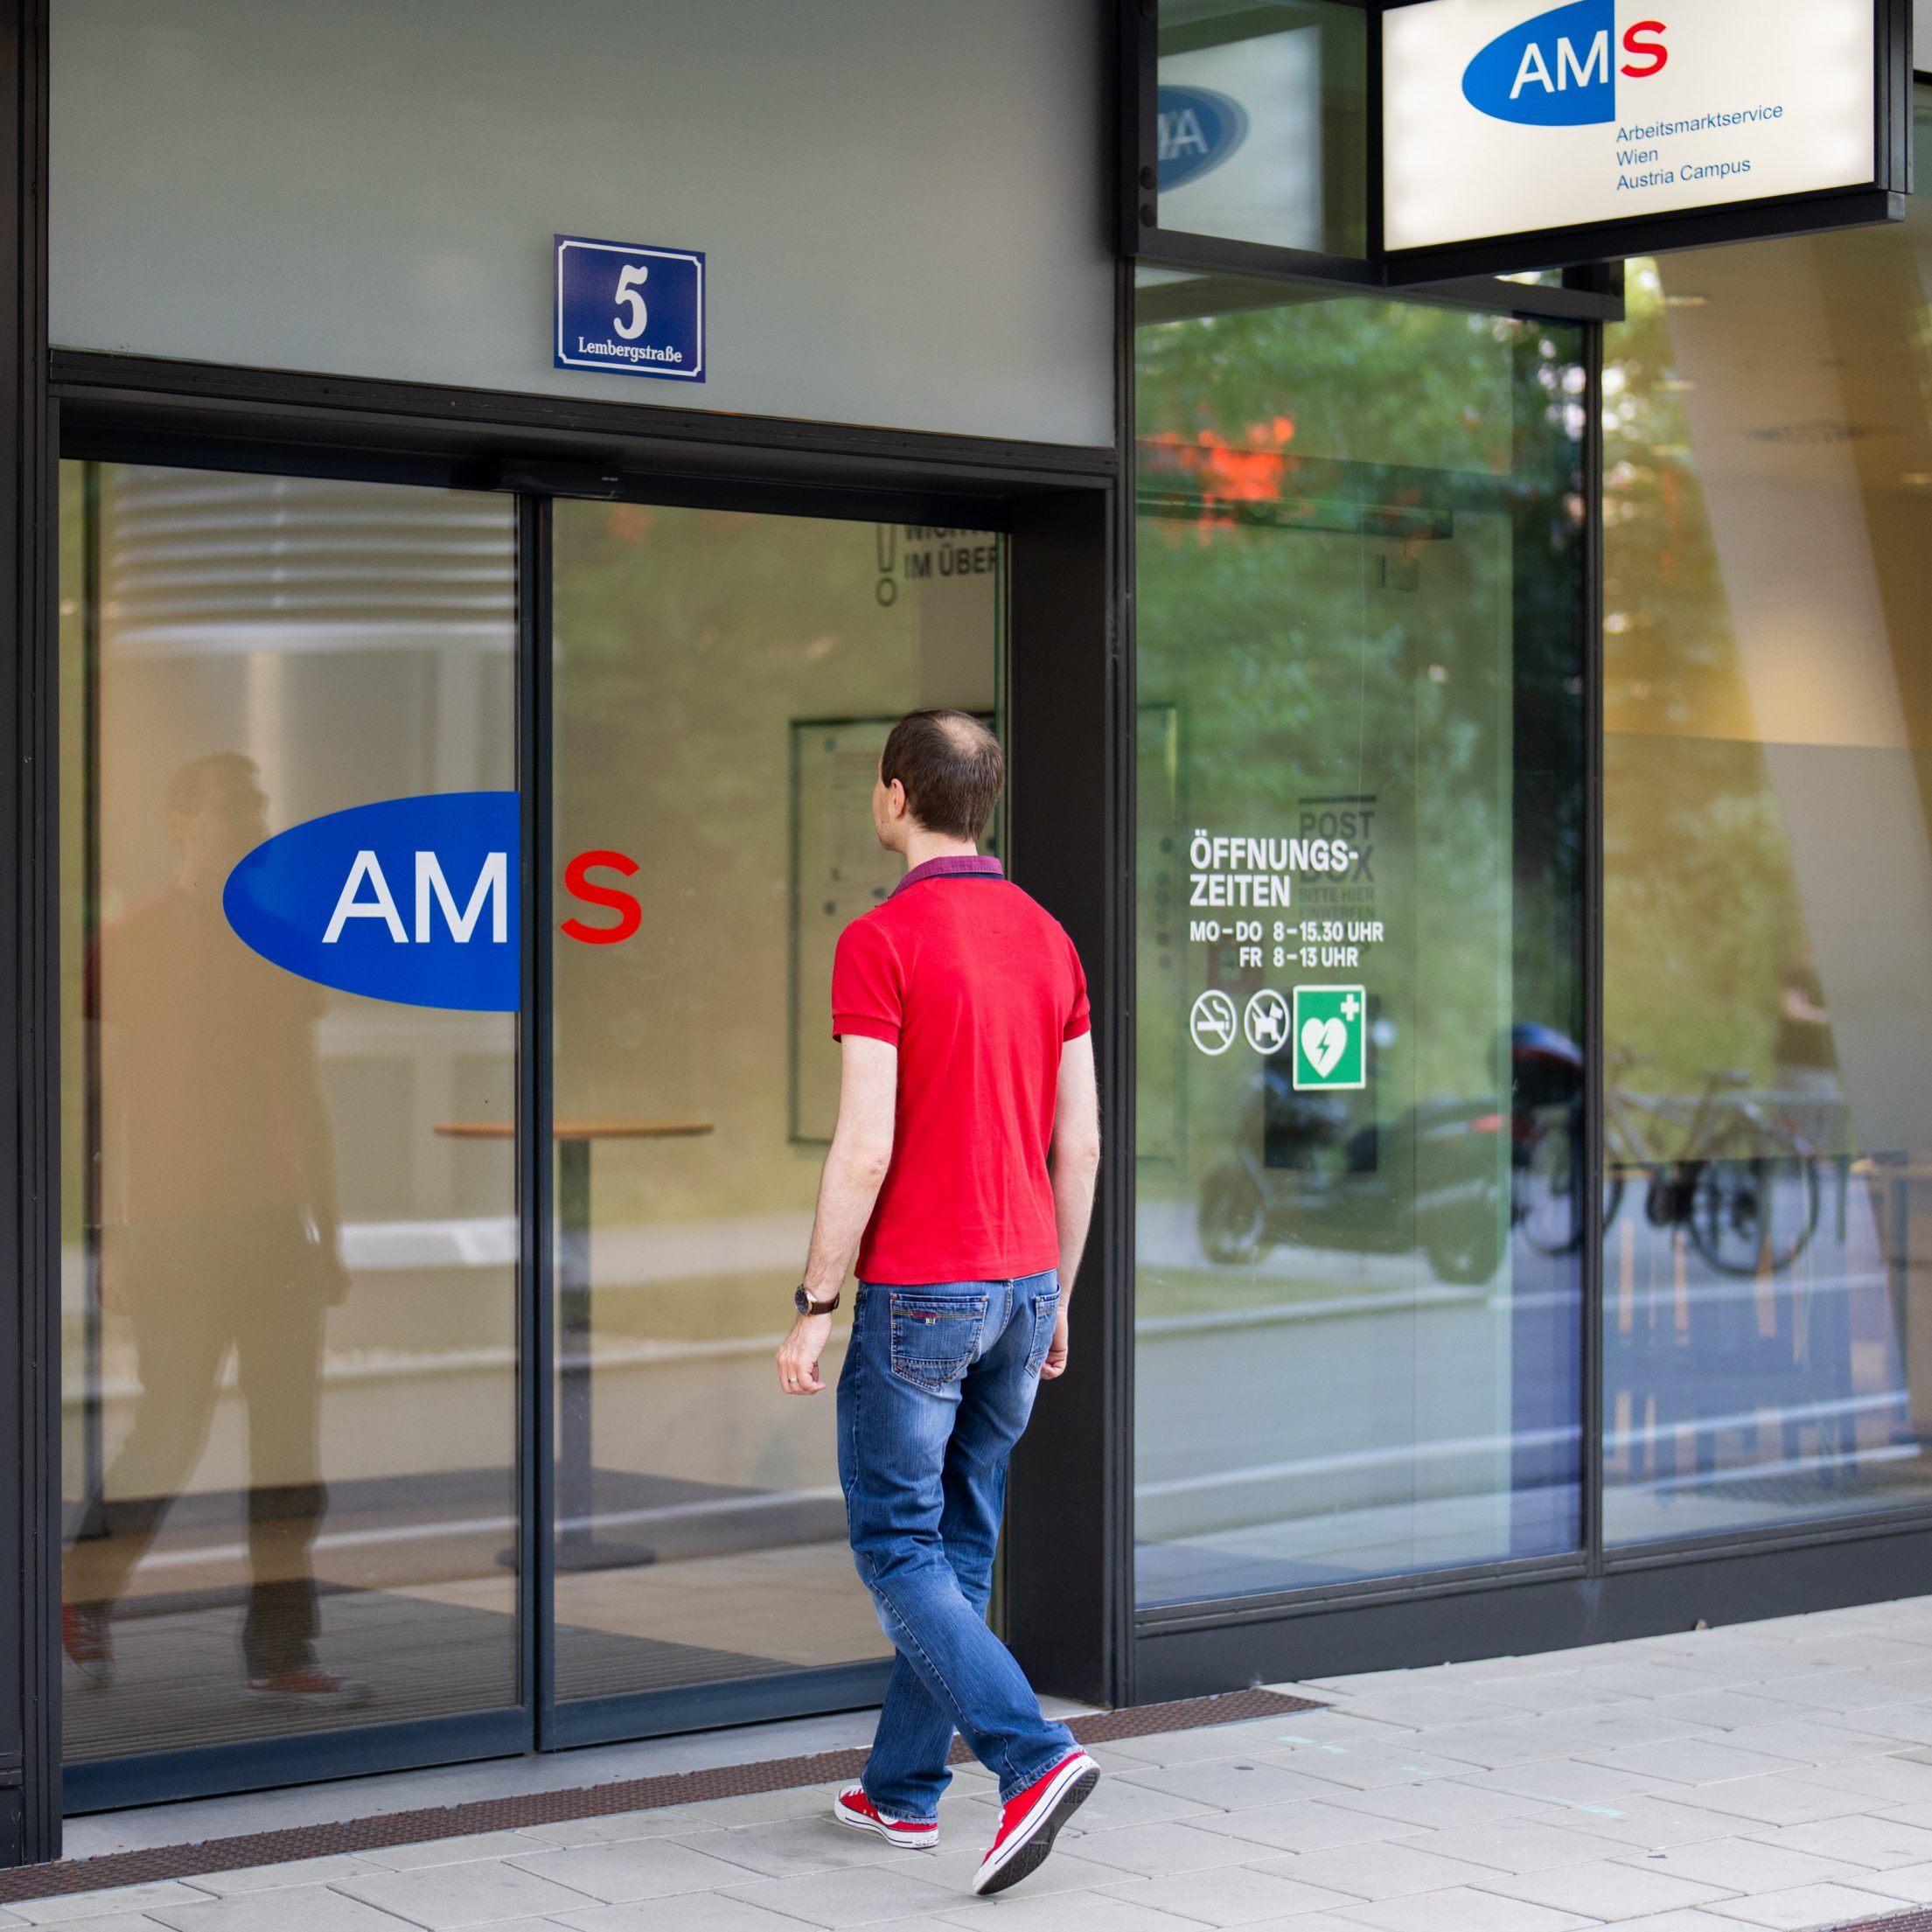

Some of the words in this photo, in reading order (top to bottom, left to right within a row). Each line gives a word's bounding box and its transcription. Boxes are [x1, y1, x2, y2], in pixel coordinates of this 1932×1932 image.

[1509, 20, 1669, 100] AMS
[1616, 103, 1783, 143] Arbeitsmarktservice
[1616, 148, 1658, 167] Wien
[1616, 166, 1674, 191] Austria
[1680, 157, 1751, 182] Campus
[613, 264, 648, 340] 5
[577, 336, 683, 363] Lembergstraße
[1299, 810, 1375, 840] POST
[1189, 828, 1359, 872] ÖFFNUNGS-
[322, 849, 643, 945] AMS
[1189, 874, 1291, 907] ZEITEN
[1347, 921, 1384, 942] UHR
[1239, 946, 1262, 967] FR
[1321, 946, 1358, 967] UHR
